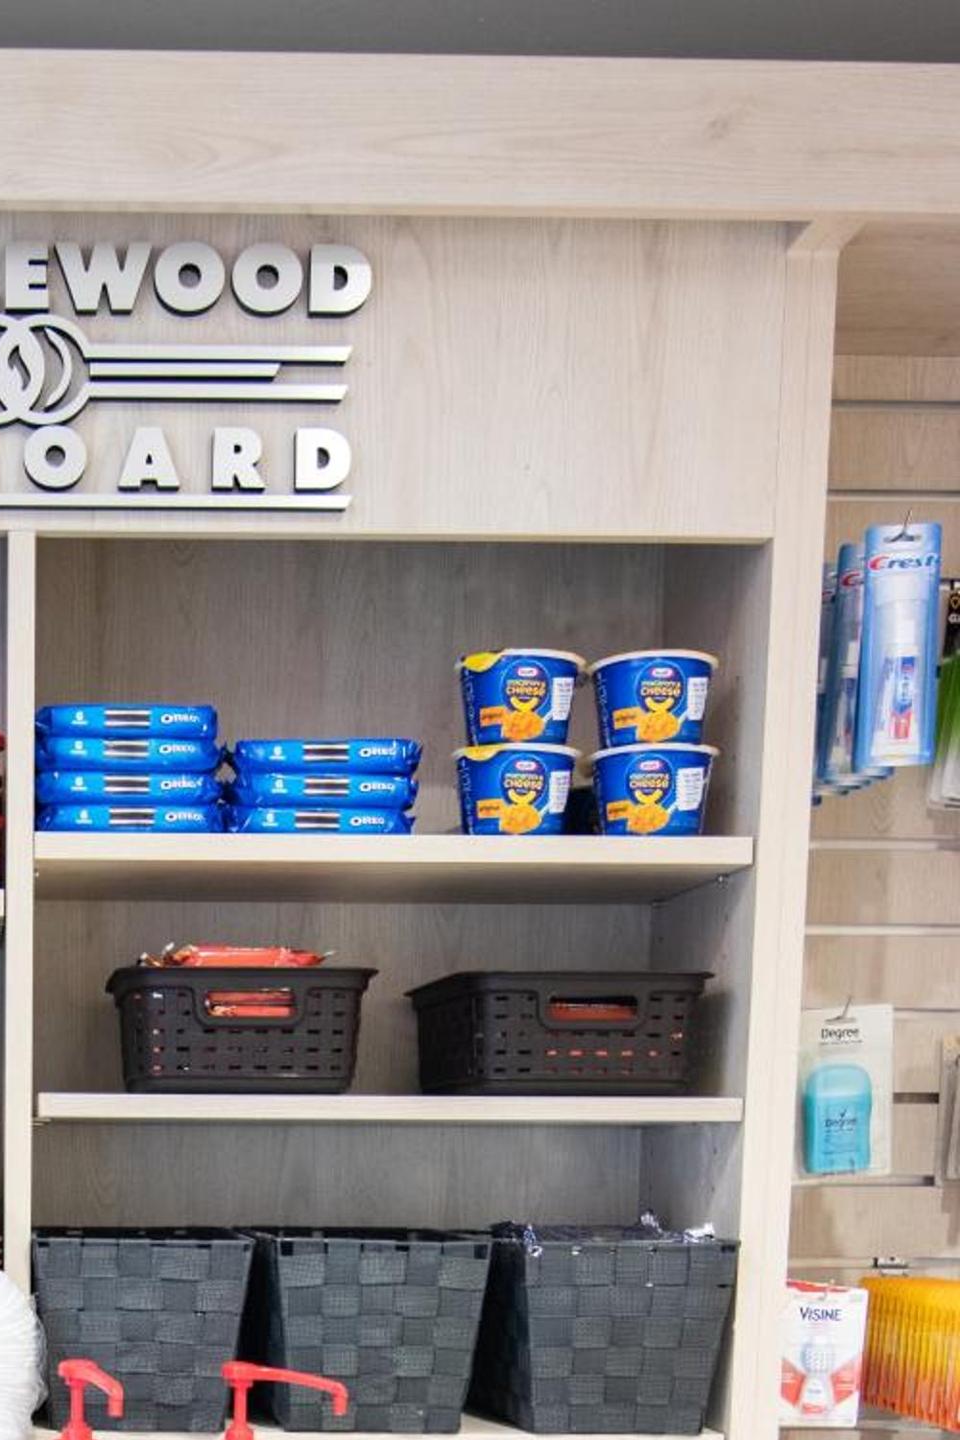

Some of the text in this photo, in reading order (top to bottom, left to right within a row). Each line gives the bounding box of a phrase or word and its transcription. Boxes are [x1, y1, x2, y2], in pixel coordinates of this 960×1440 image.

[867, 553, 942, 571] Crest
[820, 1028, 860, 1041] Degree
[799, 1307, 843, 1322] VISINE
